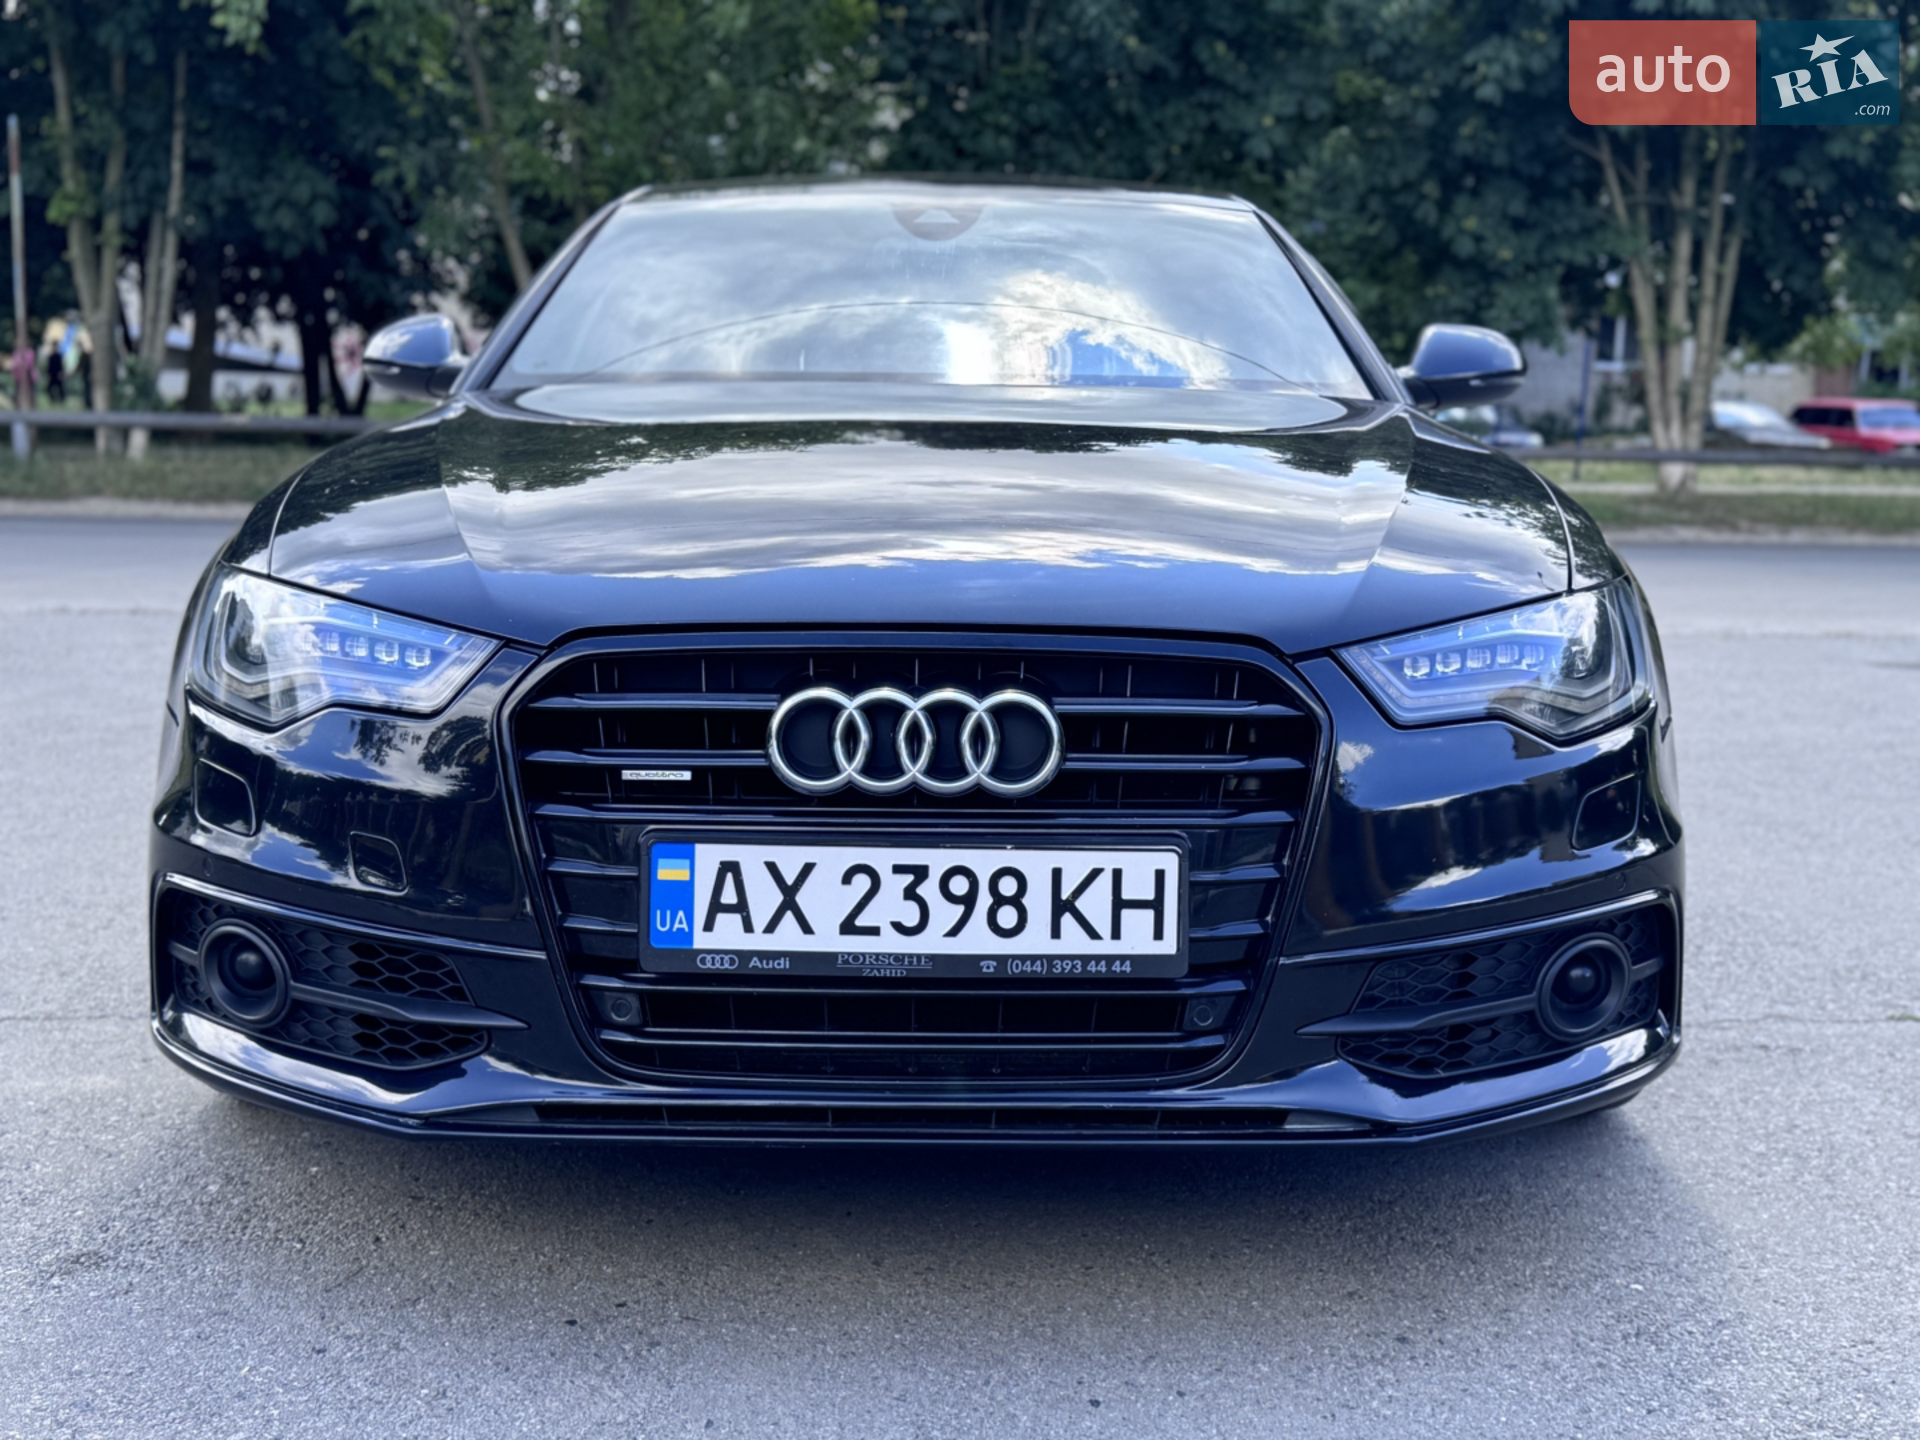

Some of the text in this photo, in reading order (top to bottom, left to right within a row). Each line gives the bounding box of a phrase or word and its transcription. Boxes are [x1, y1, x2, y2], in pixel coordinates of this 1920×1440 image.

[629, 771, 685, 780] quattro
[702, 860, 1166, 941] AX 2398 KH
[655, 908, 690, 933] UA
[748, 956, 790, 970] Audi
[836, 953, 933, 966] PORSCHE
[1007, 958, 1132, 975] (044) 393 44 44
[861, 968, 907, 977] ZAHID
